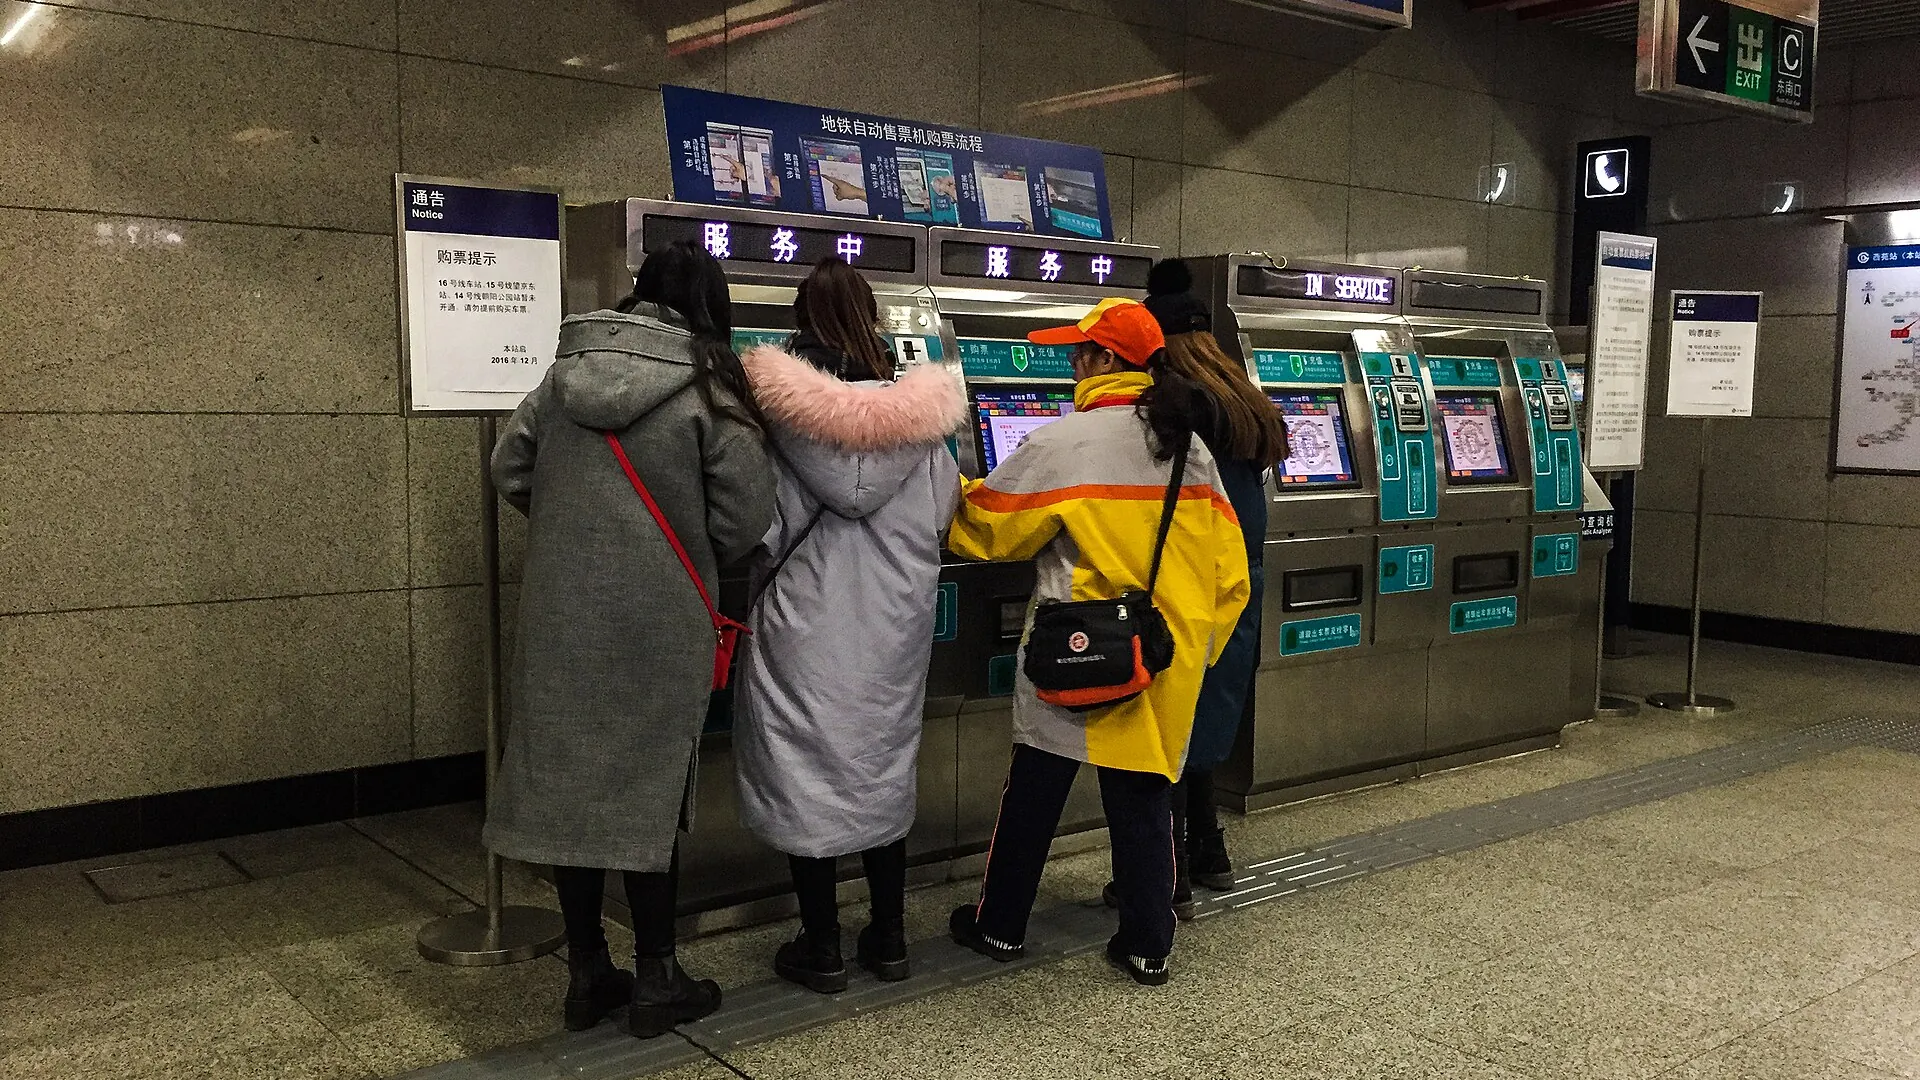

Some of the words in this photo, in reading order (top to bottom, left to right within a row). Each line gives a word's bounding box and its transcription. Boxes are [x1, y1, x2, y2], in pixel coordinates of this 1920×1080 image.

[1737, 24, 1763, 73] 出
[1783, 34, 1799, 71] C
[1735, 70, 1761, 90] EXIT
[1776, 79, 1801, 98] 东南口
[821, 114, 984, 153] 地铁自动售票机购票流程
[412, 189, 445, 207] 通告
[412, 208, 444, 219] Notice
[437, 249, 497, 266] 购票提示
[1305, 273, 1323, 297] IN
[1335, 276, 1389, 301] SERVICE
[1678, 299, 1696, 308] 通告
